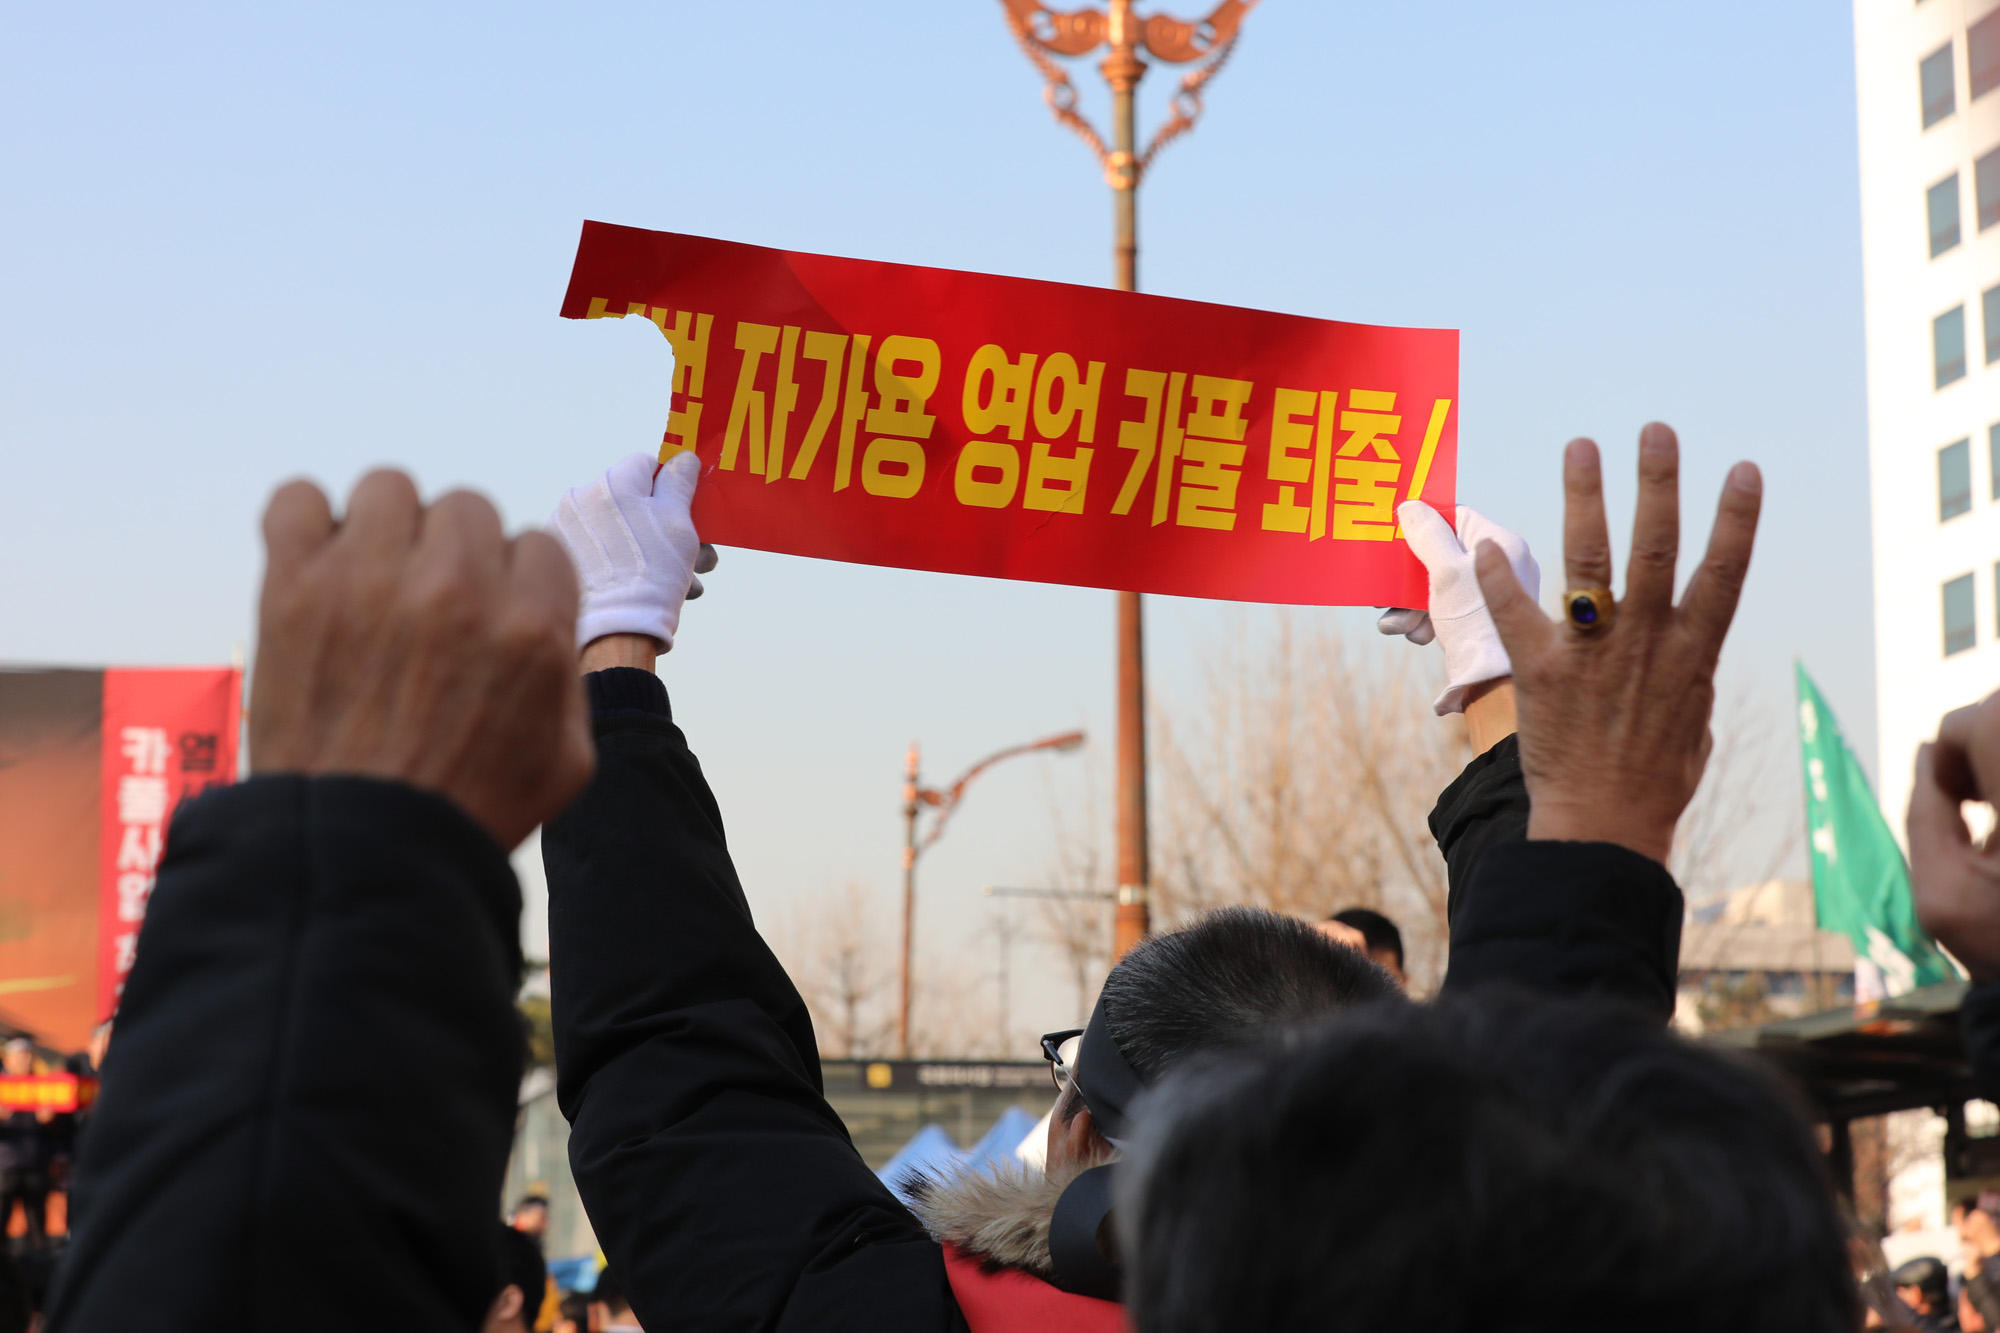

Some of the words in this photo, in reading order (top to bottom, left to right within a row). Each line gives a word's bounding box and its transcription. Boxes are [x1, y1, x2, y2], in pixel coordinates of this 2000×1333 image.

[718, 321, 941, 499] 자가용
[954, 343, 1106, 515] 영업
[1110, 367, 1254, 531] 카풀
[1261, 387, 1452, 543] 퇴출!
